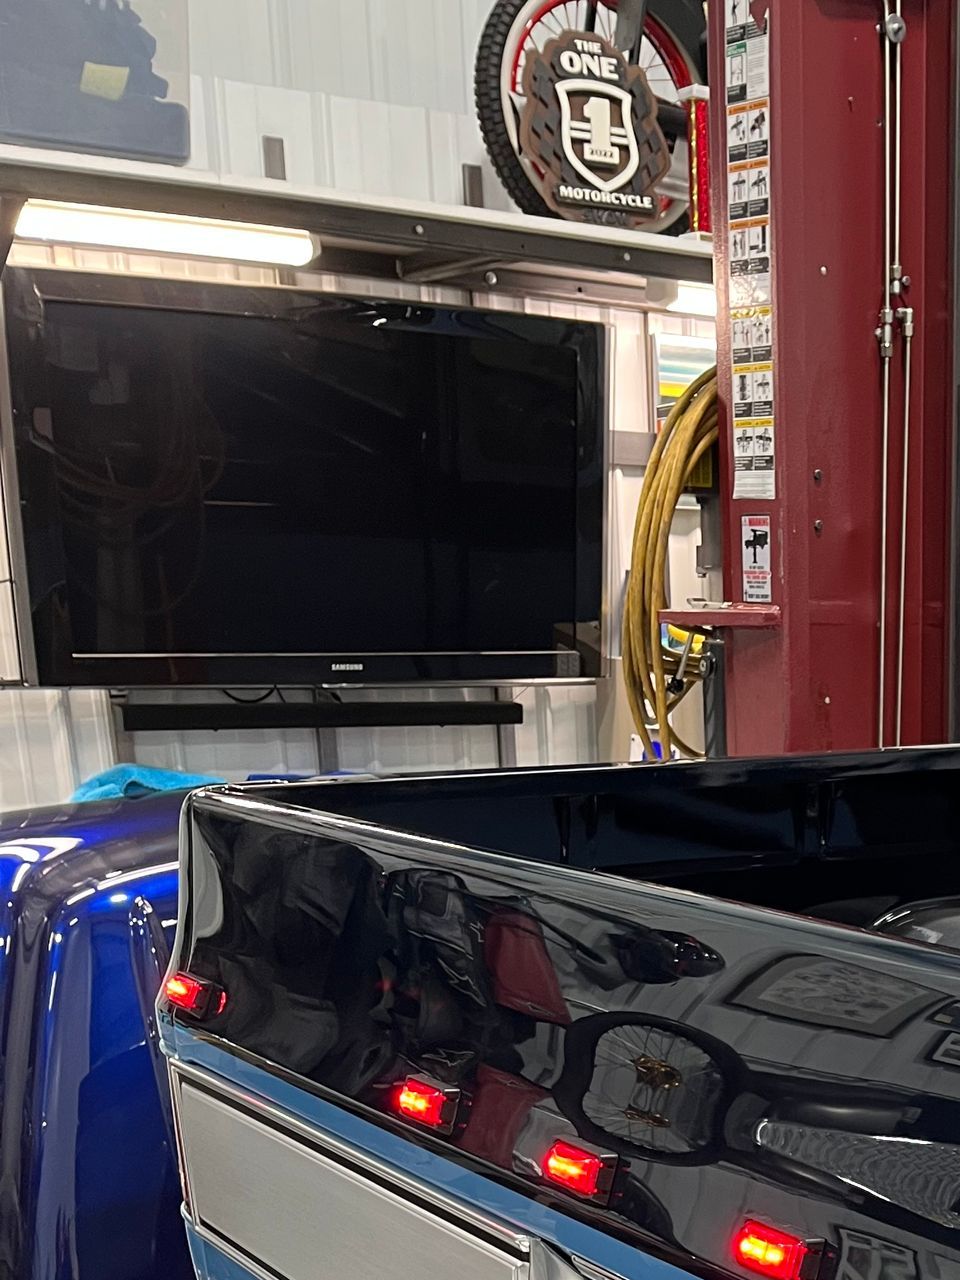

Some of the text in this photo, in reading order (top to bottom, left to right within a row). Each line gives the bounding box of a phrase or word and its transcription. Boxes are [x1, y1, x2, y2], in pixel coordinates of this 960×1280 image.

[574, 39, 602, 53] THE
[559, 50, 620, 81] ONE
[583, 97, 620, 165] 1
[559, 185, 654, 209] MOTORCYCLE
[331, 663, 364, 671] SAMSUNG
